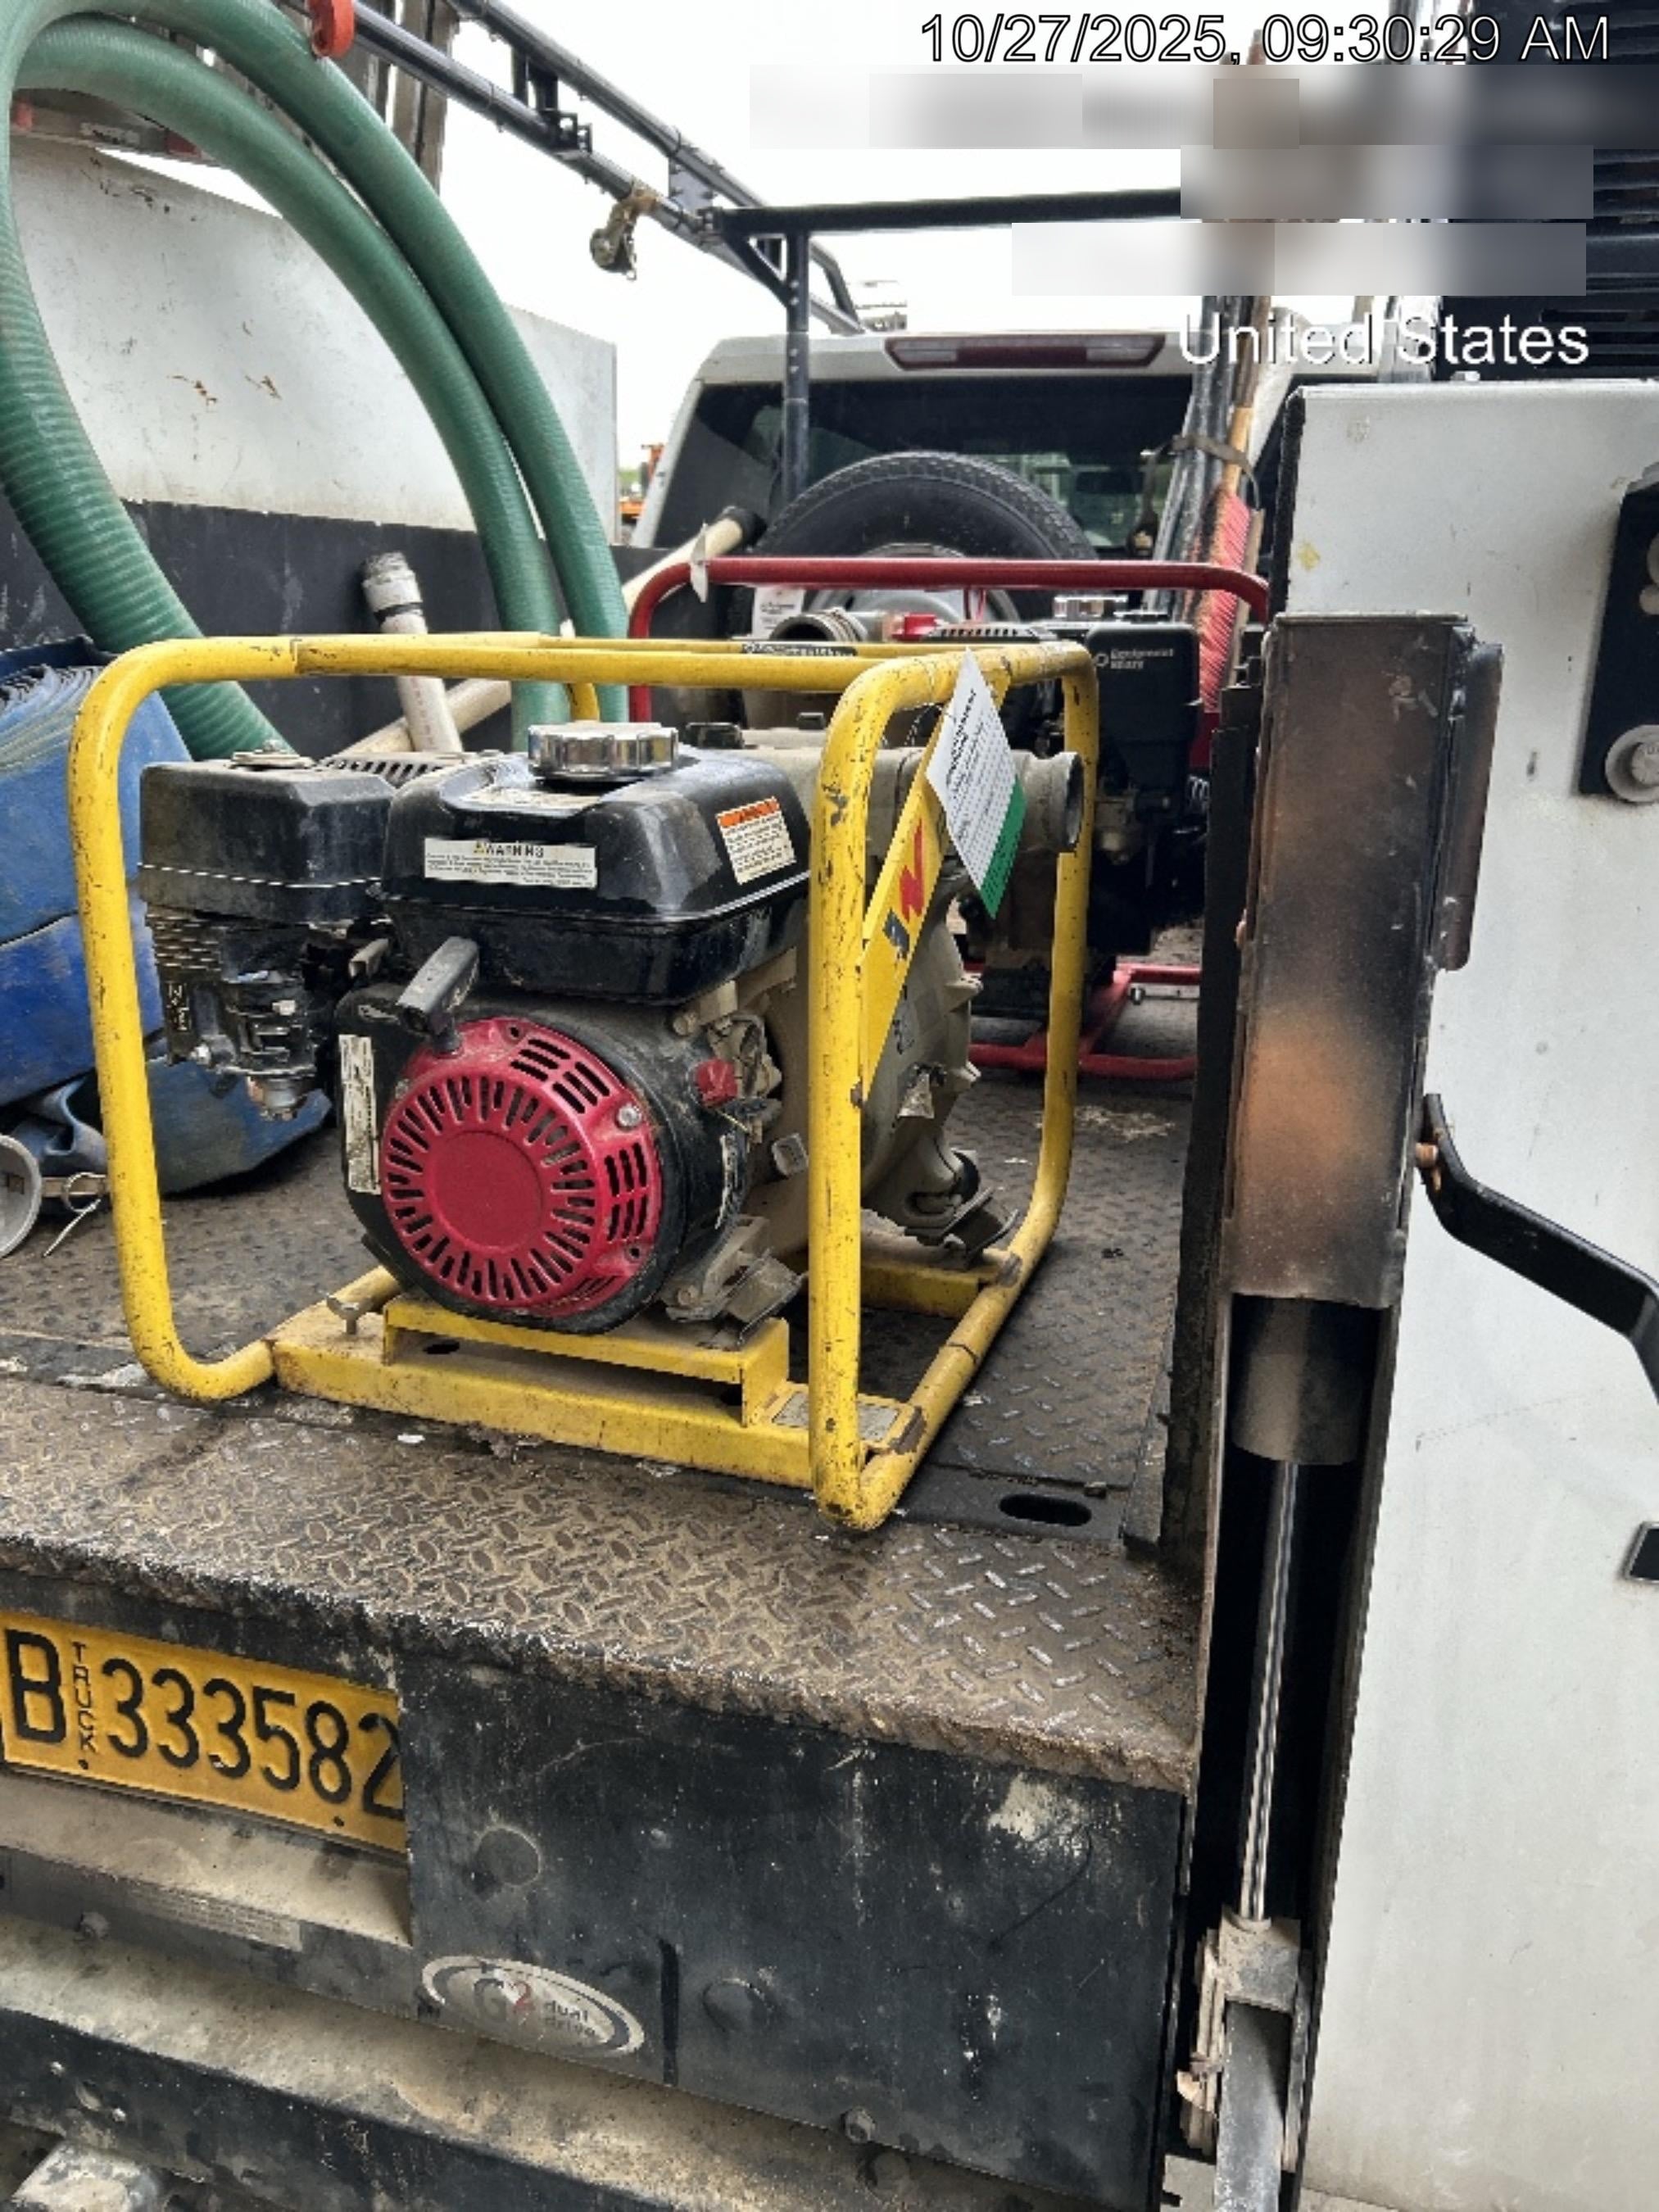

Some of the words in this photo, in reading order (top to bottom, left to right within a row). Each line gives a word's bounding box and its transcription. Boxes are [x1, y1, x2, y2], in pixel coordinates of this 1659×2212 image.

[485, 843, 545, 859] WANNG
[4, 1629, 66, 1744] B
[70, 1641, 99, 1753] TRUCK
[101, 1657, 406, 1821] 333582
[544, 2000, 589, 2022] dual
